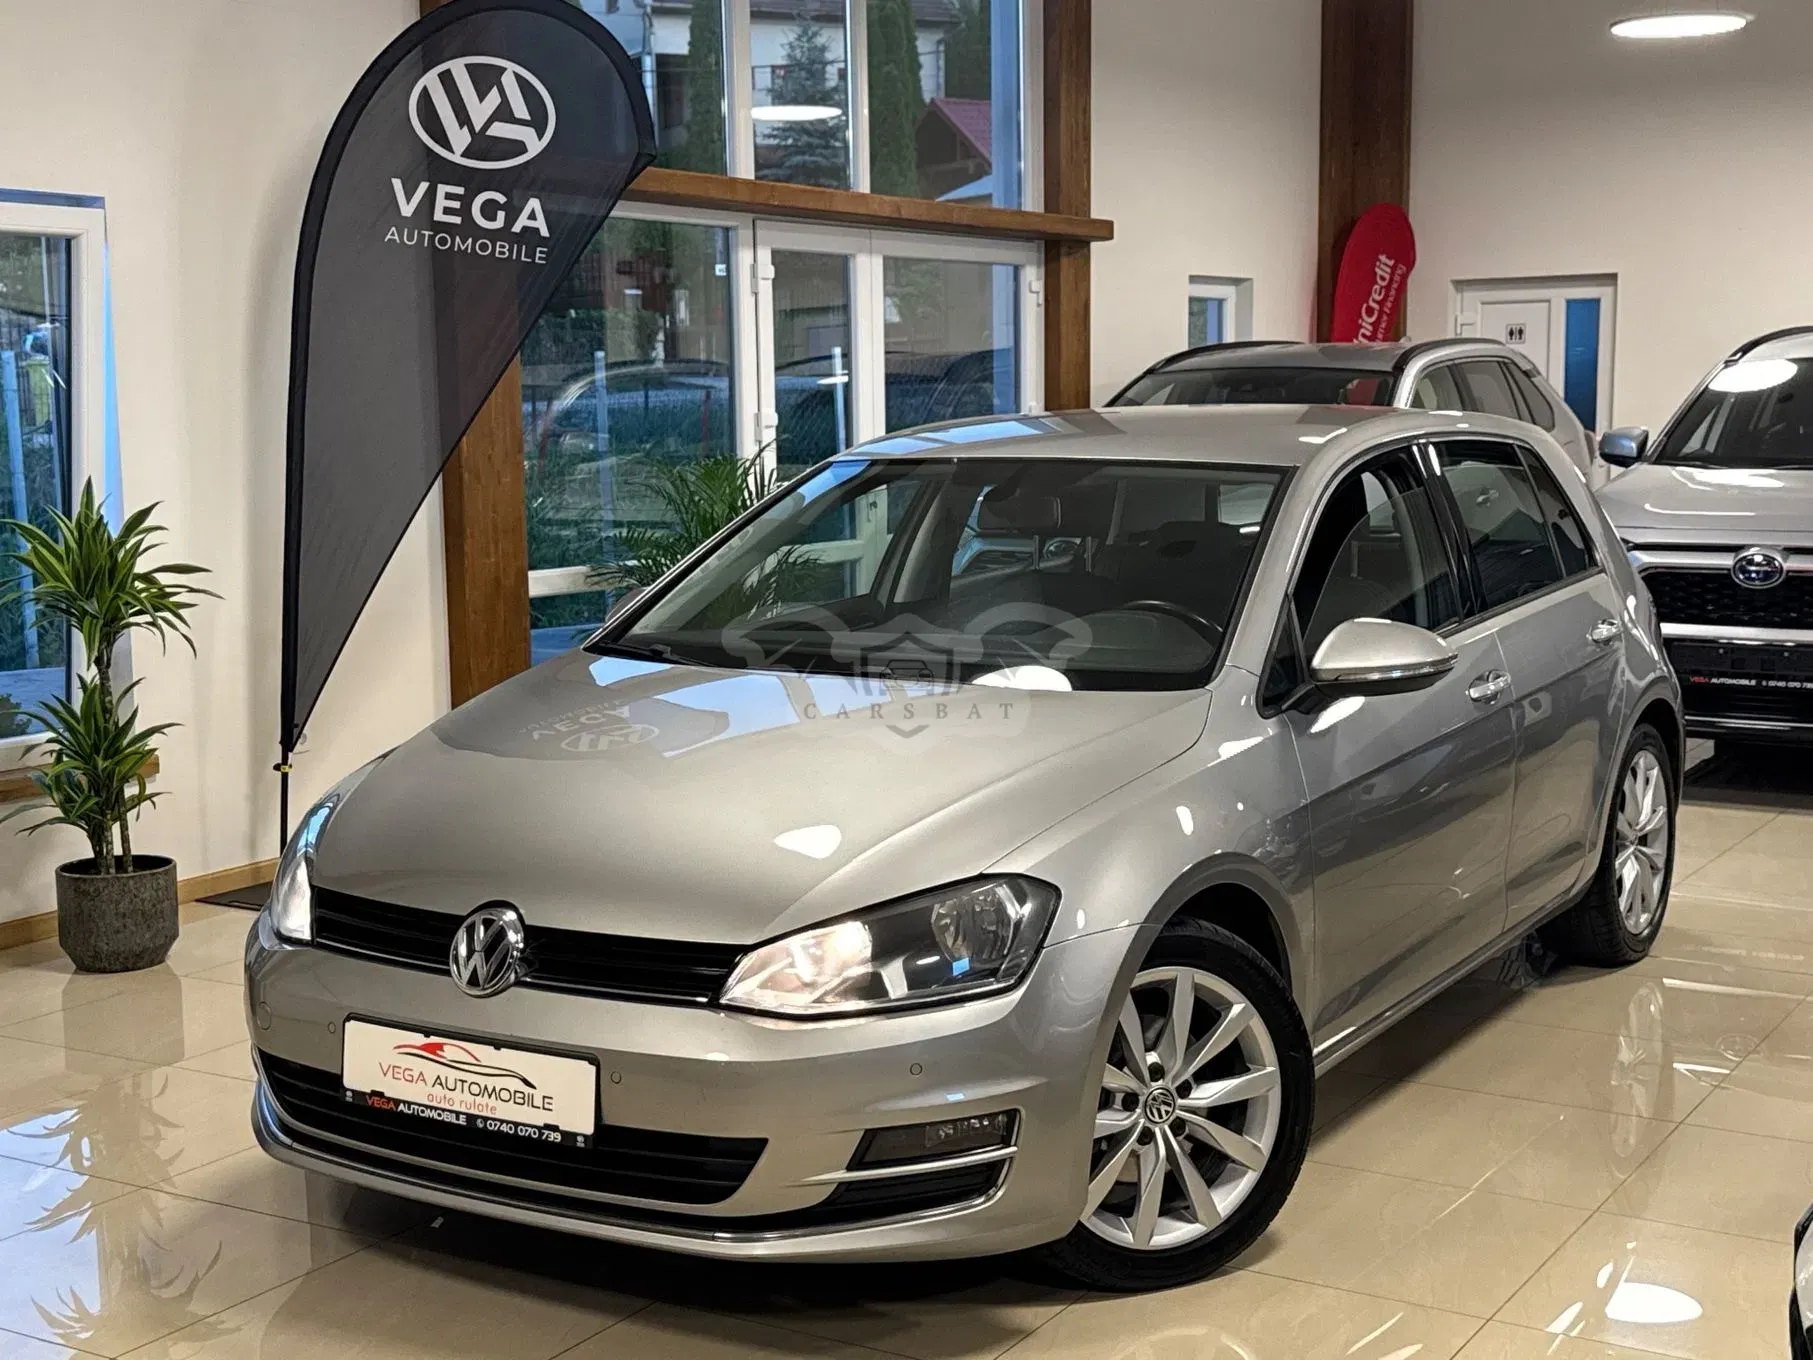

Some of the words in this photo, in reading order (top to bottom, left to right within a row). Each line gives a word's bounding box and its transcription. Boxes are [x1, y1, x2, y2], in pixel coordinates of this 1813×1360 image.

[391, 177, 550, 238] VEGA
[384, 226, 549, 264] AUTOMOBILE
[378, 1062, 428, 1086] VEGA
[432, 1074, 554, 1112] AUTOMOBILE
[426, 1093, 455, 1107] auto
[459, 1098, 497, 1115] rulate
[365, 1095, 396, 1111] VEGA
[397, 1103, 467, 1126] AUTOMOBILE
[486, 1120, 515, 1134] 0740
[517, 1125, 539, 1139] 070
[541, 1128, 562, 1143] 739
